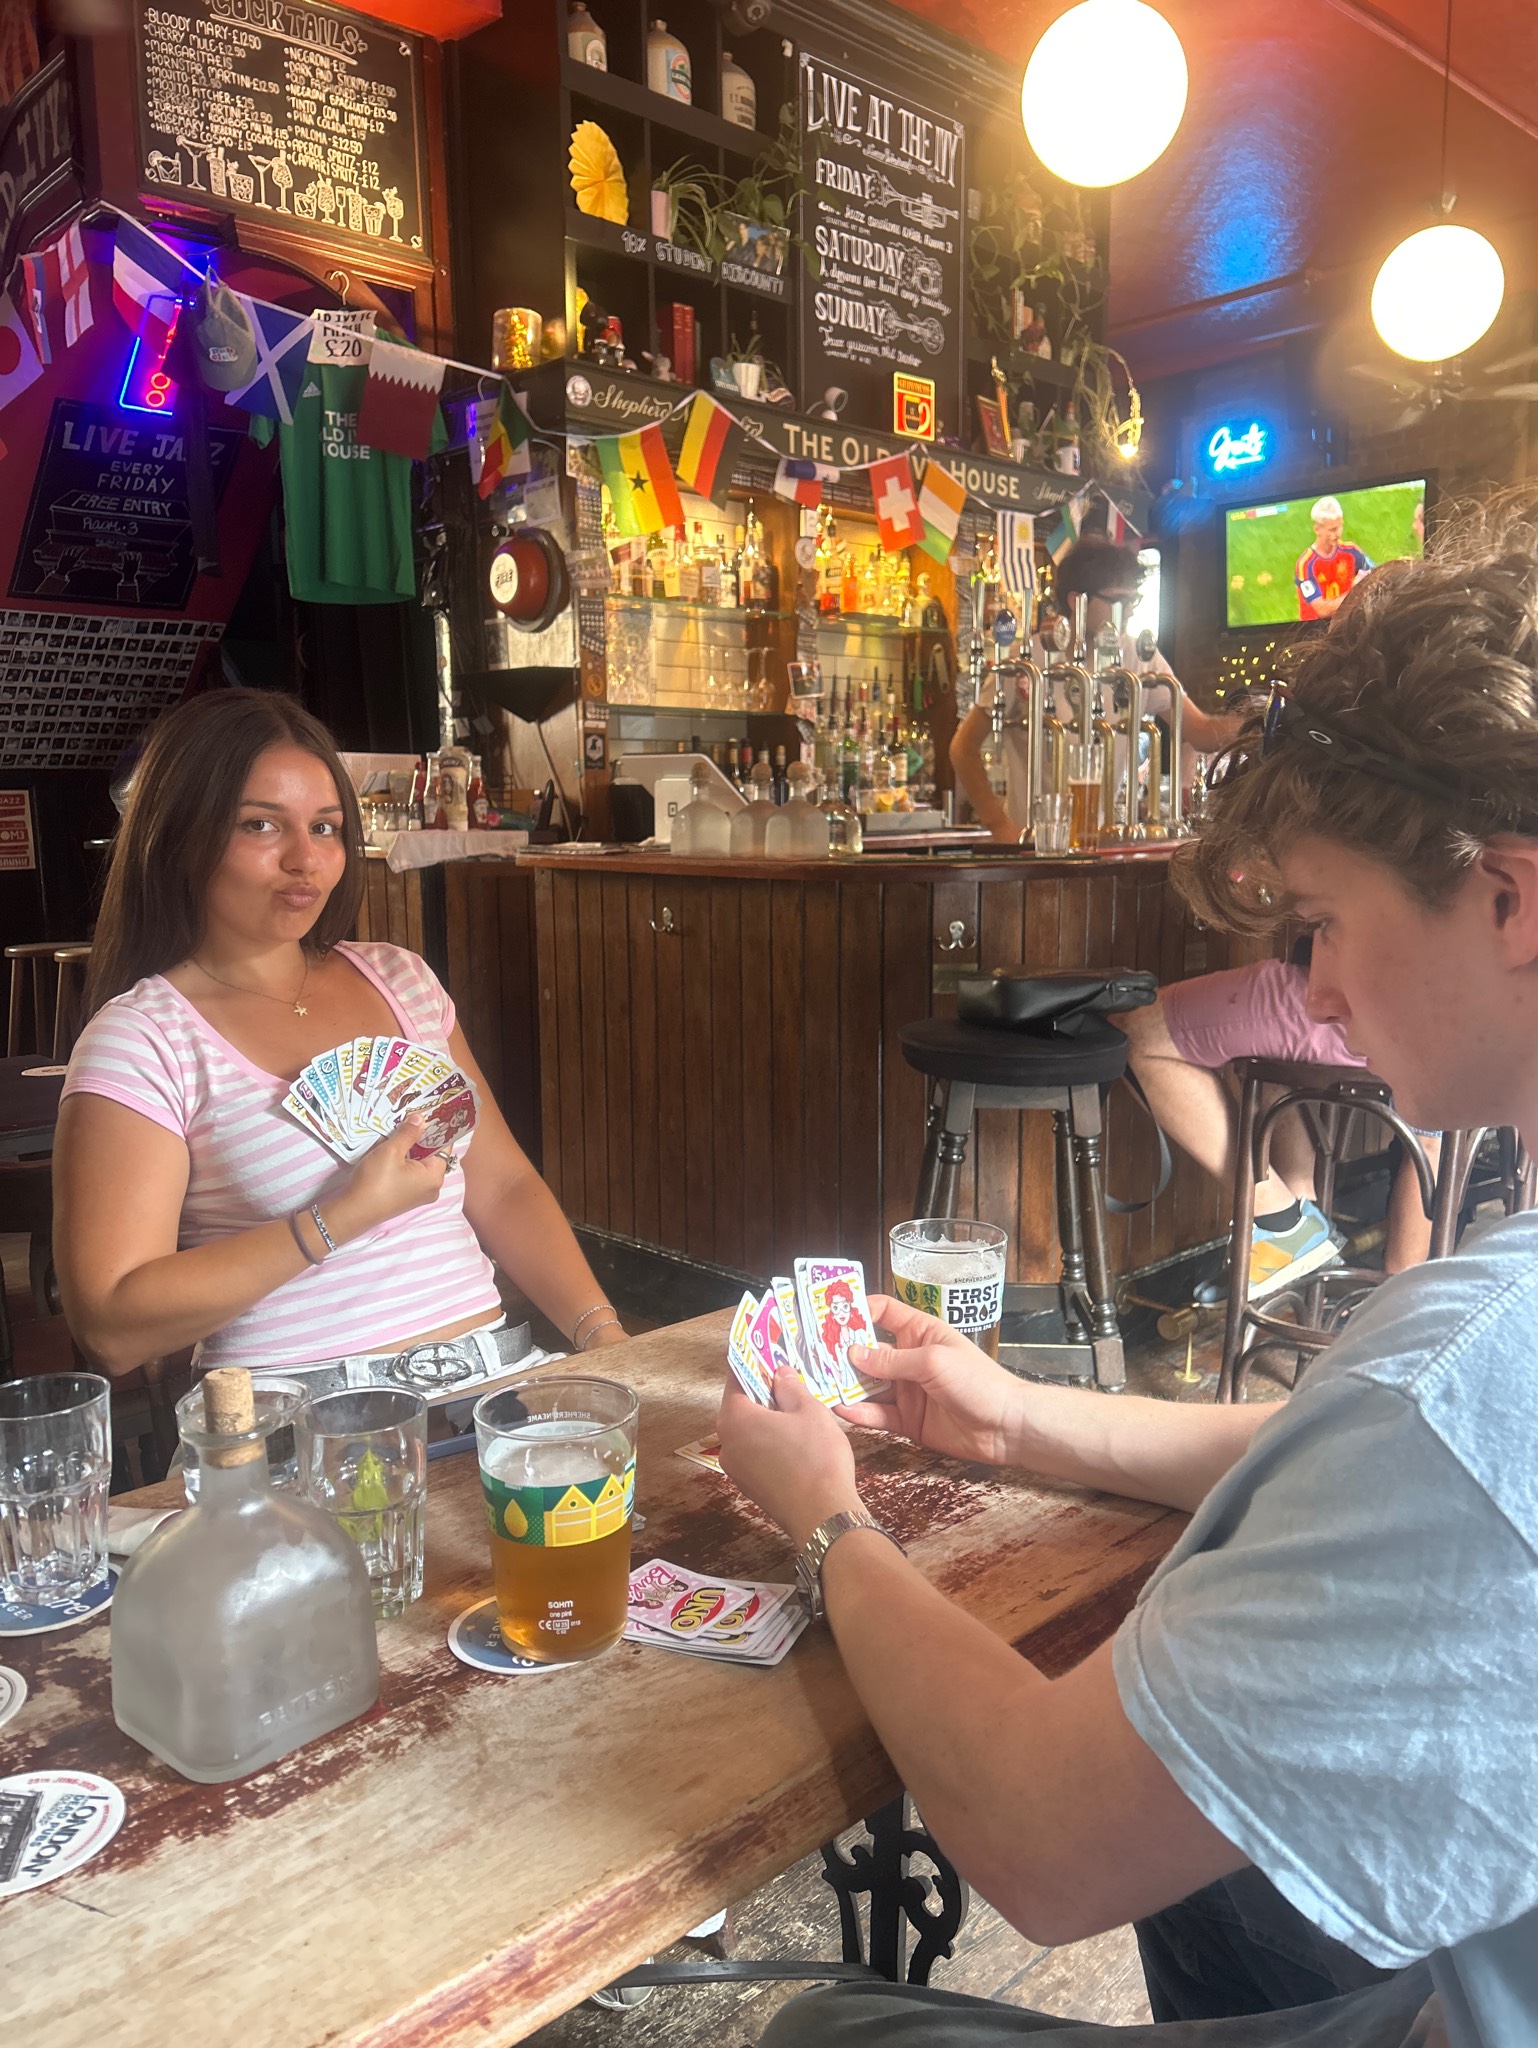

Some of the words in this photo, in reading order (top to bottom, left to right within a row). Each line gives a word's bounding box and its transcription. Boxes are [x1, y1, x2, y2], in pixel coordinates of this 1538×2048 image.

[148, 7, 191, 32] BLOODY
[212, 0, 359, 55] COCKTAILS
[148, 23, 185, 43] CHERRY
[151, 51, 204, 76] PORNSTAR
[289, 61, 313, 78] DARK
[315, 67, 333, 83] AND
[152, 77, 189, 95] MOJITO
[290, 73, 305, 86] OLD
[152, 89, 200, 110] ESPRESSO
[153, 100, 198, 118] TURMERIC
[290, 96, 317, 115] TINTO
[322, 105, 340, 121] CON
[154, 110, 204, 132] ROSEMARY
[156, 122, 198, 139] HIBISCUS
[806, 65, 862, 133] LIVE
[865, 95, 894, 144] AT
[898, 108, 933, 165] THE
[934, 125, 958, 188] IVY
[292, 139, 323, 160] APEROL
[292, 152, 330, 175] CAMPARI
[815, 158, 873, 200] FRIDAY
[655, 242, 713, 273] STUDENT
[815, 224, 906, 280] SATURDAY
[335, 313, 357, 323] IVY
[814, 292, 885, 336] SUNDAY
[325, 339, 362, 358] £20
[592, 384, 674, 418] Shepherd
[324, 411, 357, 427] THE
[62, 421, 139, 456] LIVE
[152, 434, 225, 465] JAZ
[322, 426, 344, 442] LD
[110, 460, 165, 476] EVERY
[783, 423, 834, 462] THE
[950, 460, 1020, 500] HOUSE
[97, 473, 175, 494] FRIDAY
[71, 494, 122, 511] FREE
[122, 499, 172, 517] ENTRY
[395, 1046, 405, 1057] 4
[948, 1282, 999, 1304] FIRST
[947, 1300, 998, 1325] DROP
[956, 1325, 982, 1334] ESSION
[0, 1602, 34, 1620] AGER
[671, 1587, 727, 1632] UNO
